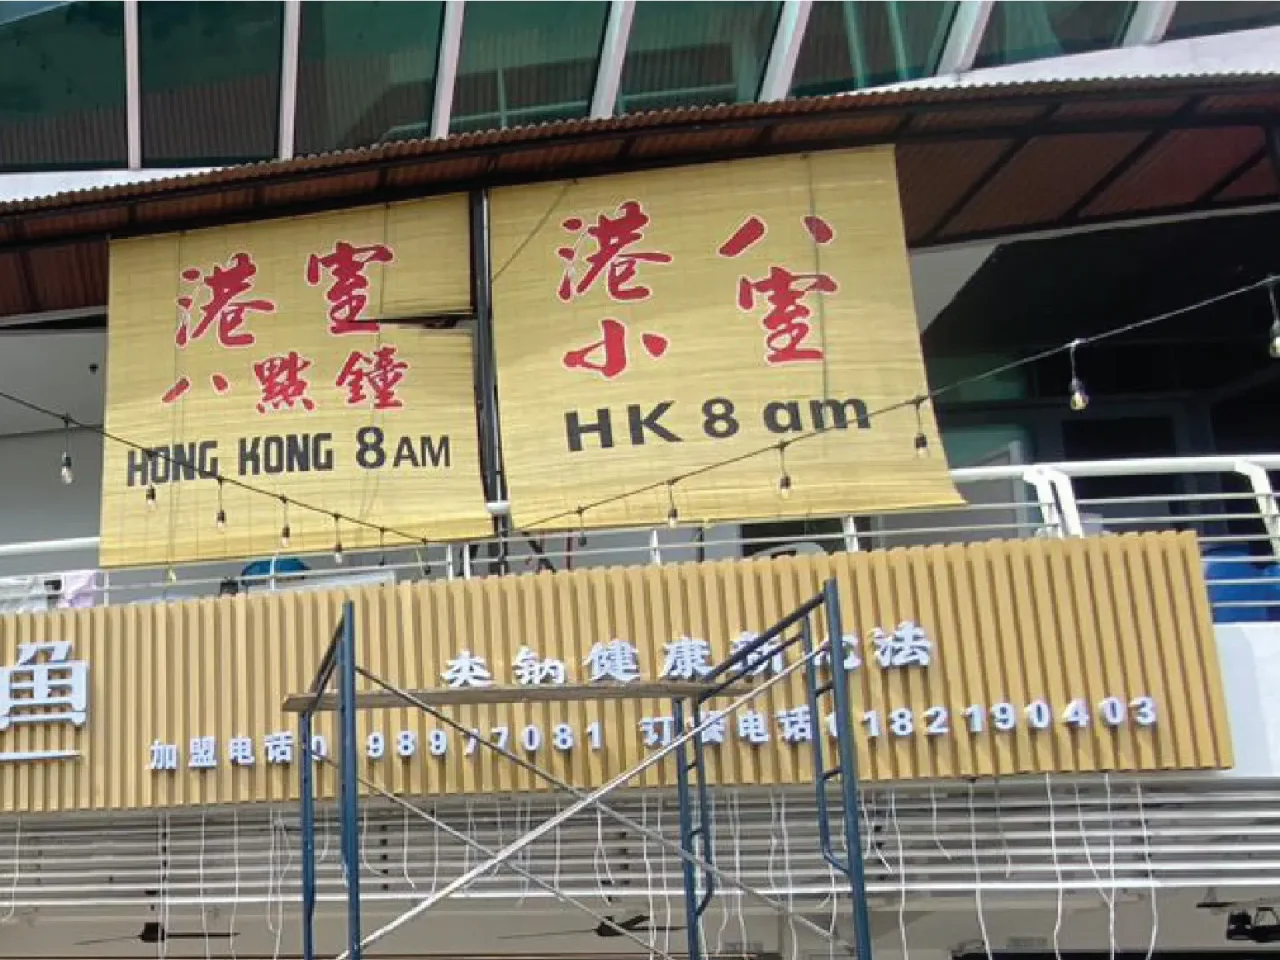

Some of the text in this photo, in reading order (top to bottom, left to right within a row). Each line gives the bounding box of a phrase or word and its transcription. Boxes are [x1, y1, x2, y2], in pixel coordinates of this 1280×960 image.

[564, 396, 871, 452] HK 8 am
[127, 440, 219, 487] HONG
[238, 432, 333, 476] KONG
[311, 720, 602, 761] 098977081
